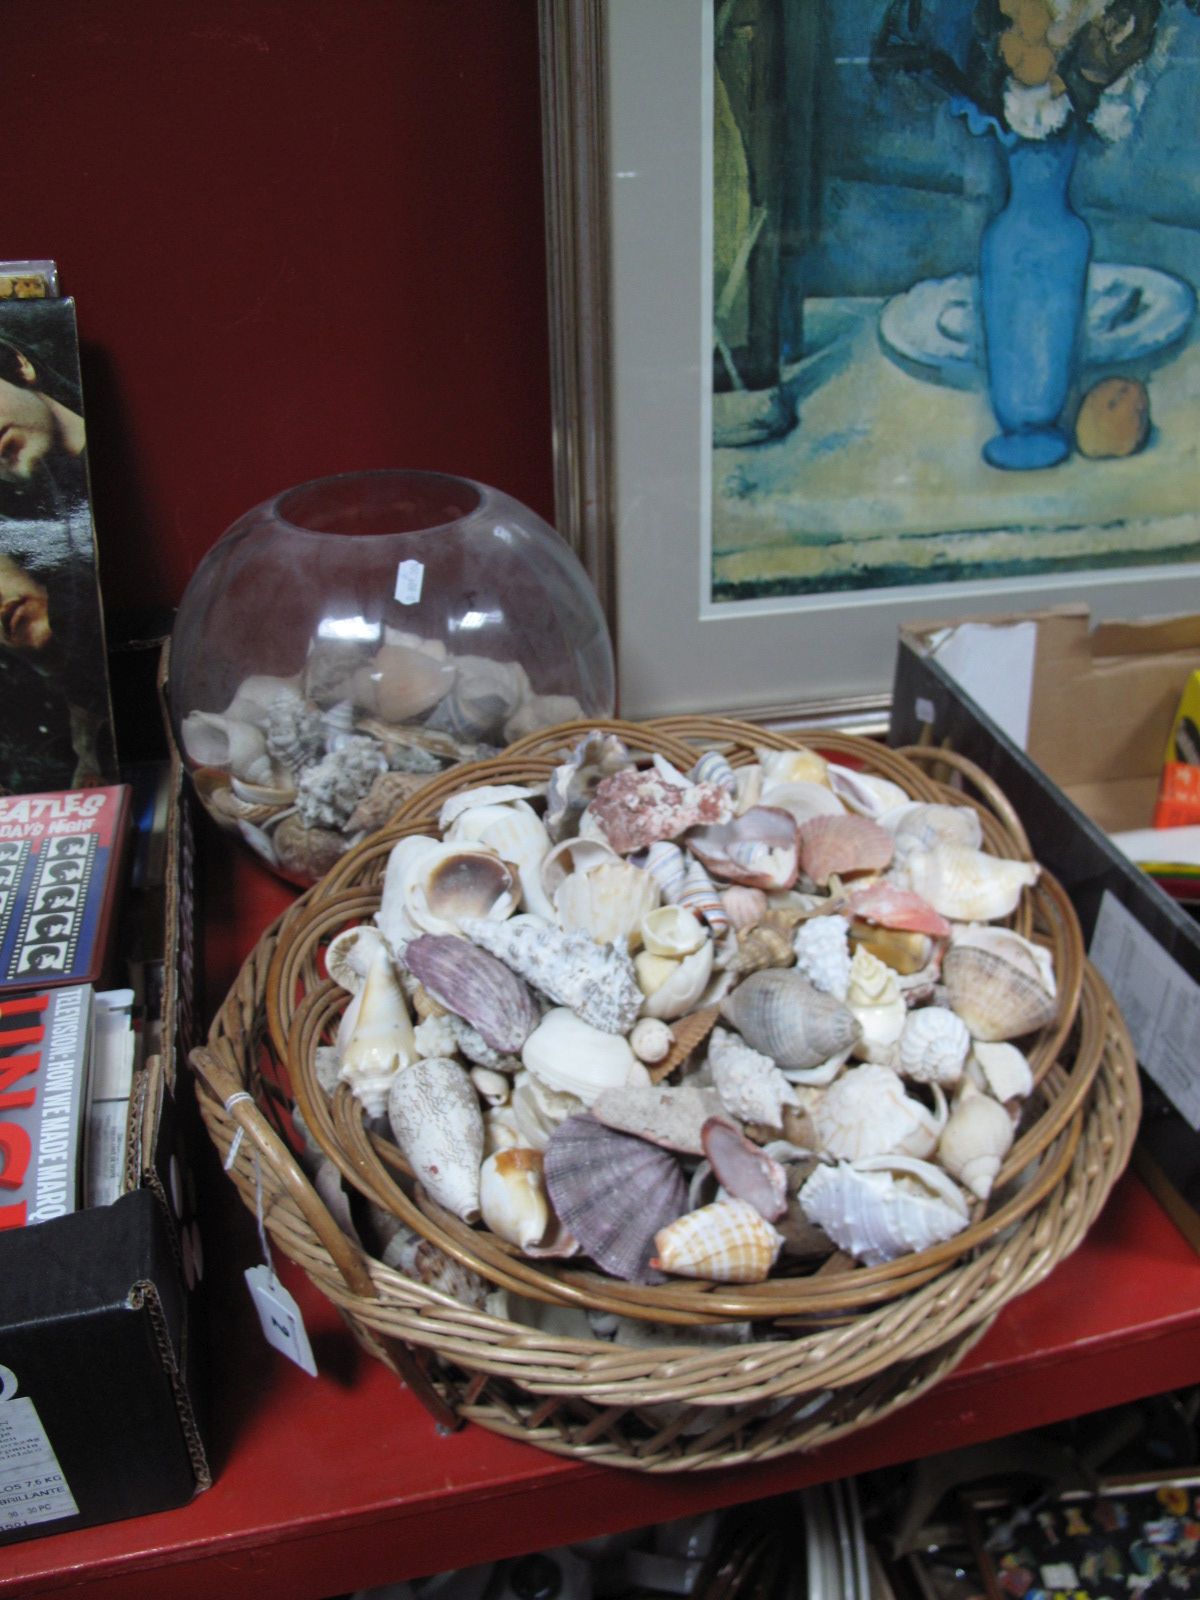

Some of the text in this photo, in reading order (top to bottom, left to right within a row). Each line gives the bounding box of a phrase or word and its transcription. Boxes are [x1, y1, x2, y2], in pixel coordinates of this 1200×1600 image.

[49, 988, 82, 1061] TELEVISION:
[45, 1059, 75, 1092] HOW
[42, 1092, 72, 1117] WE
[38, 1115, 71, 1164] MADE
